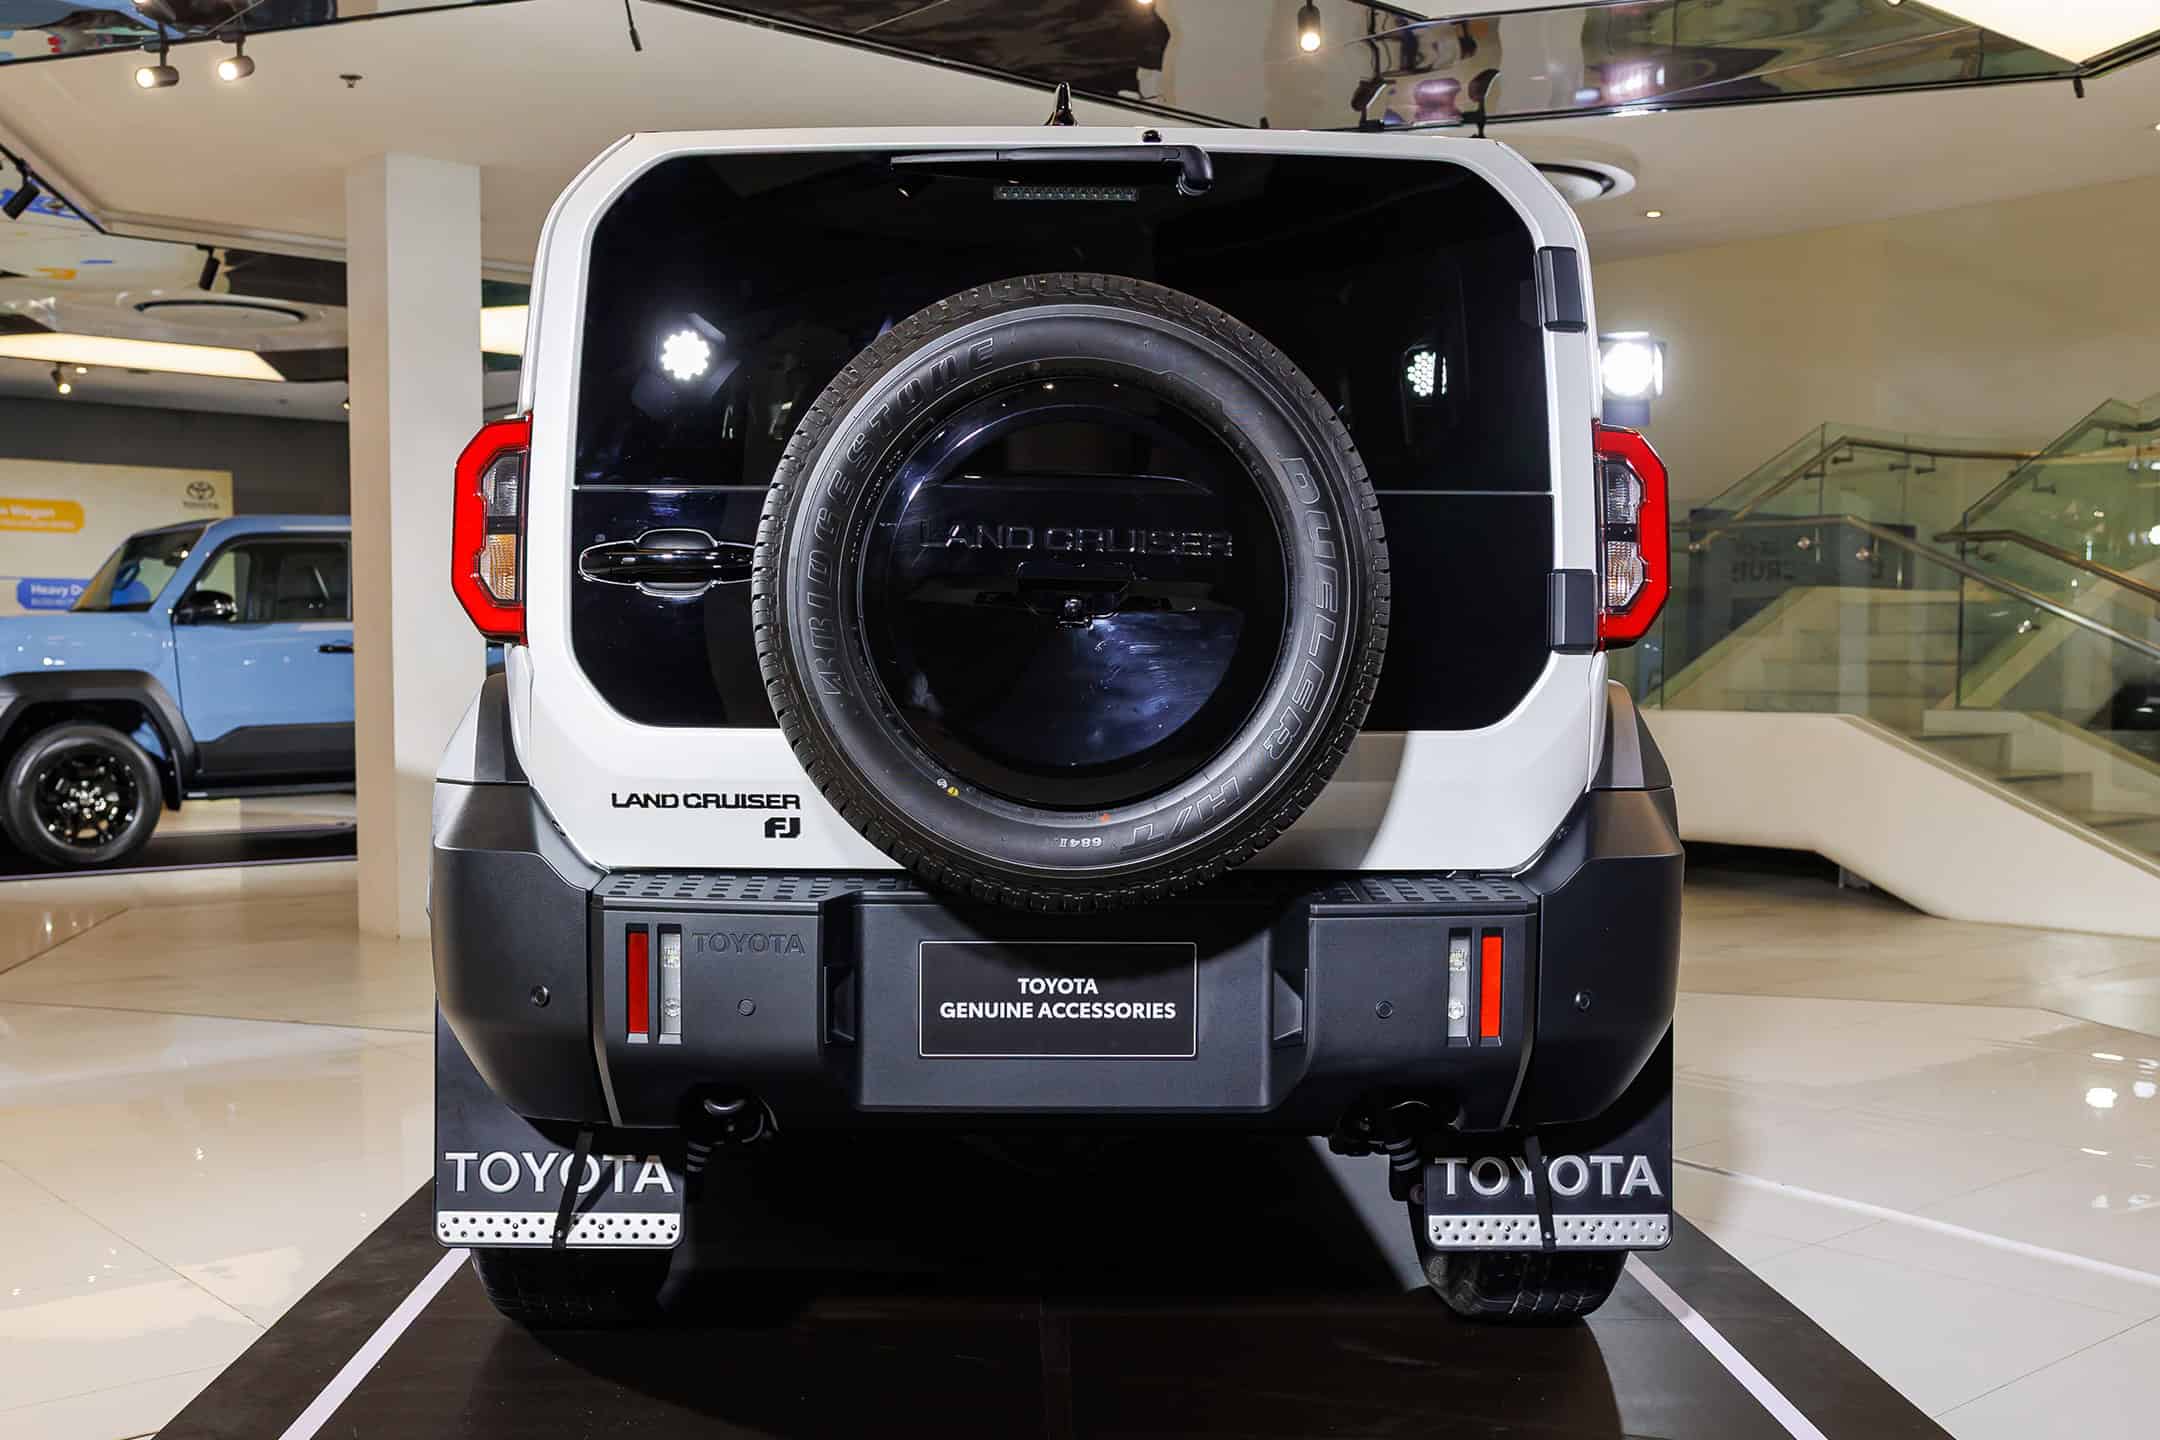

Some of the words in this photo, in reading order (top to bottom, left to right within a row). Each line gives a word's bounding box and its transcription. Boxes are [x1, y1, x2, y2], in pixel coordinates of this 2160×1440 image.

[805, 336, 993, 695] BRIDGESTONE
[920, 520, 1034, 550] LAND
[1046, 526, 1233, 557] CRUISER
[31, 584, 68, 599] Heavy
[1263, 456, 1339, 761] DUELER
[611, 792, 680, 809] LAND
[682, 792, 801, 810] CRUISER
[1119, 775, 1240, 854] H/T
[764, 816, 801, 839] FJ
[691, 932, 806, 955] TOYOTA
[1016, 977, 1100, 995] TOYOTA
[939, 1002, 1034, 1020] GENUINE
[1036, 1002, 1177, 1020] ACCESSORIES
[444, 1151, 675, 1194] TOYOTA
[1434, 1154, 1663, 1197] TOYOTA
